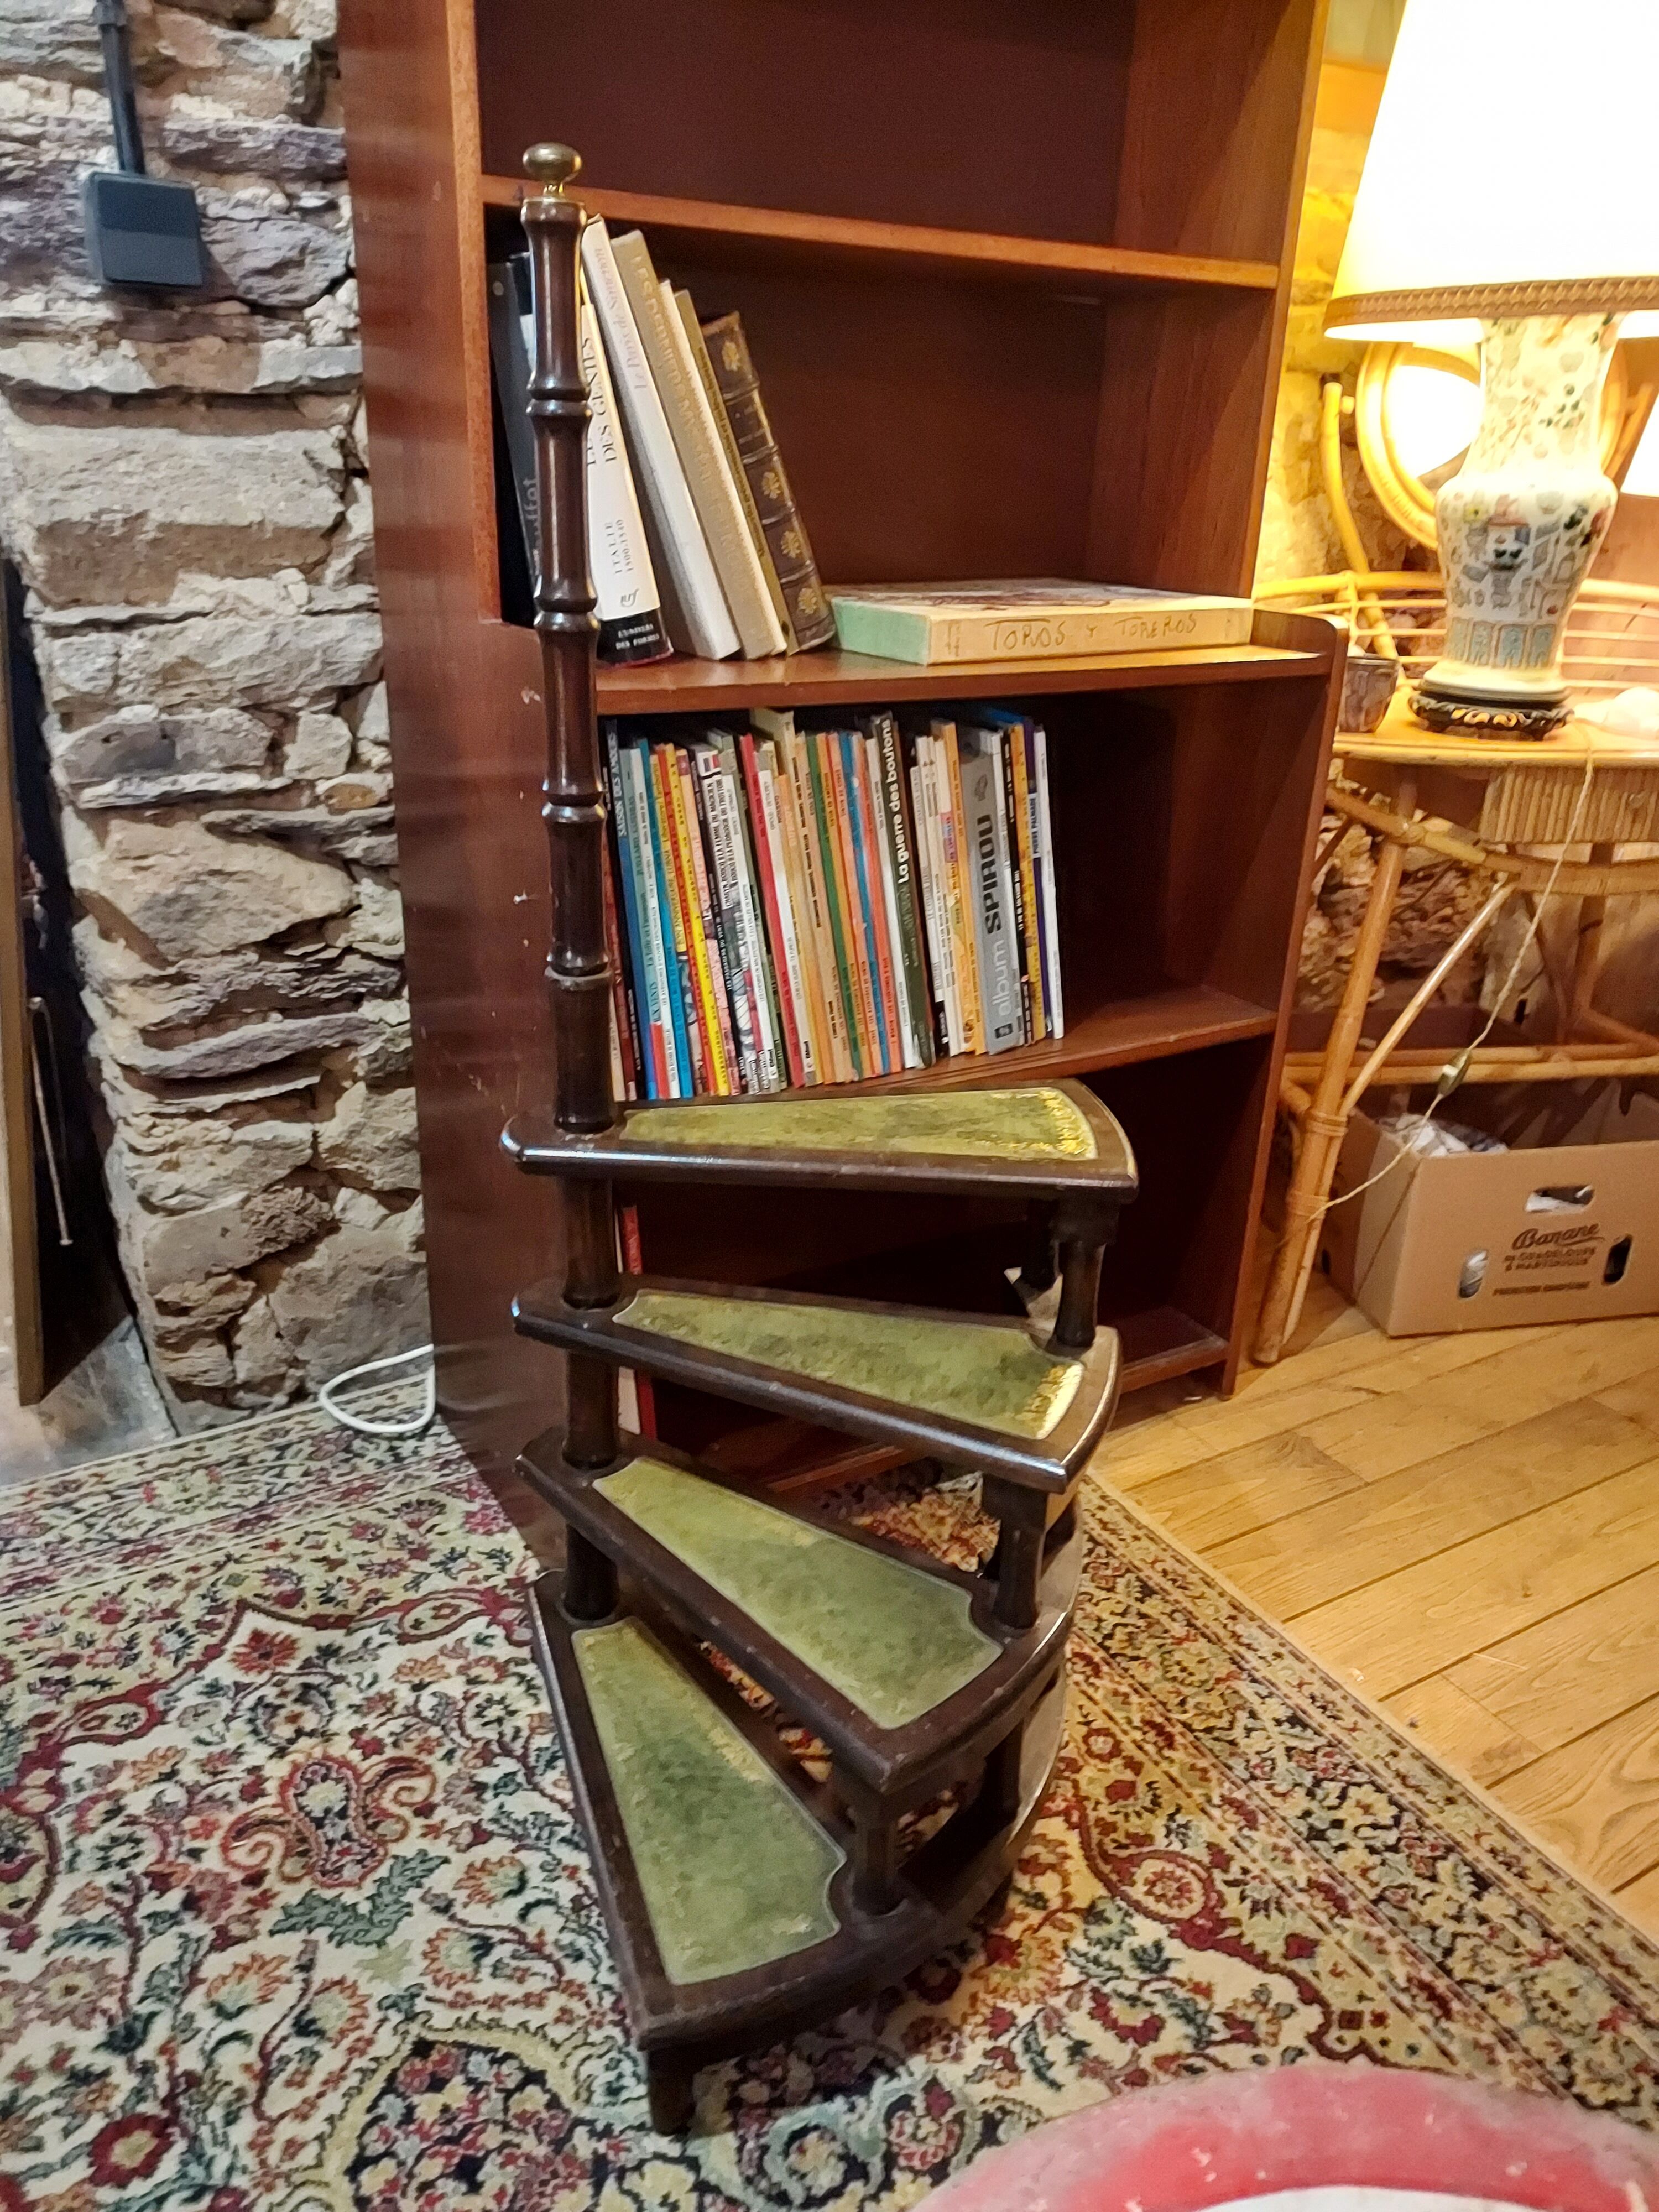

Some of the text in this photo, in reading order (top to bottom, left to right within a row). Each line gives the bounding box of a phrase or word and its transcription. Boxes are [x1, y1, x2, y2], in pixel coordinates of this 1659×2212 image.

[598, 424, 617, 462] DES
[604, 521, 622, 573] ITALIE
[612, 777, 622, 797] DES
[879, 719, 910, 883] La guerre des boutons
[614, 800, 627, 836] SAISON
[975, 813, 1011, 1016] album SPIROU
[1511, 1223, 1603, 1251] Banane
